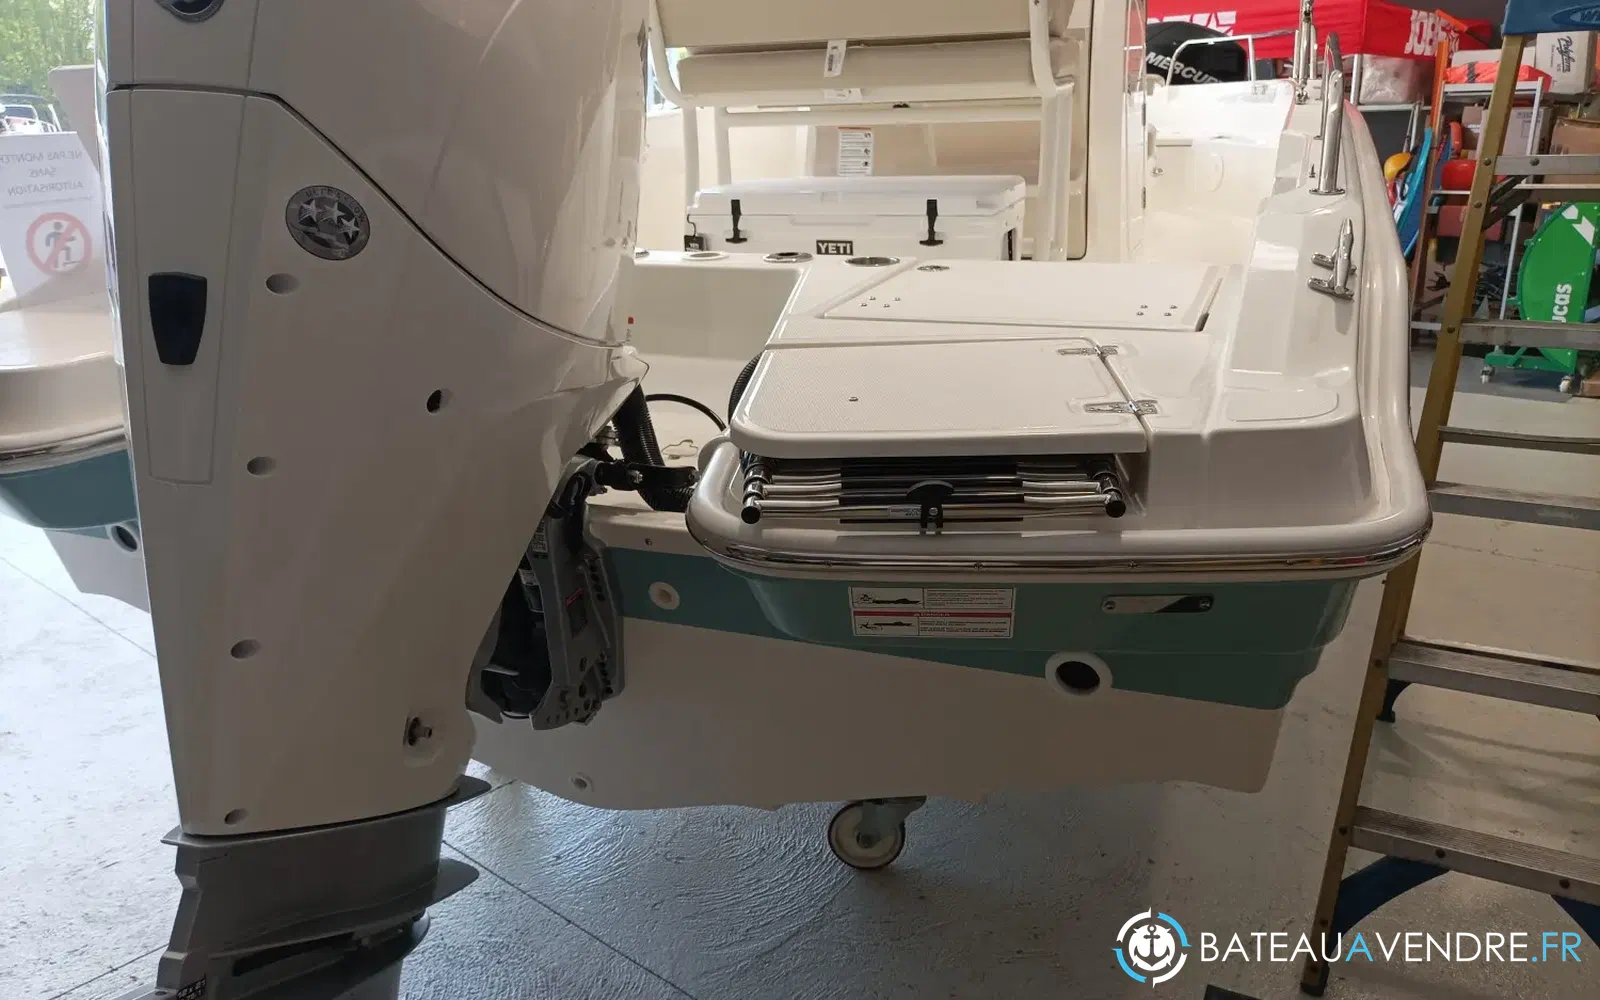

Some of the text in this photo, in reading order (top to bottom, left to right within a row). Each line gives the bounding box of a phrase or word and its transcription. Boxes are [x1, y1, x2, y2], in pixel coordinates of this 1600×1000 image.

[1145, 51, 1223, 84] MERCUR
[817, 242, 851, 254] YETI
[1552, 284, 1572, 323] ucas
